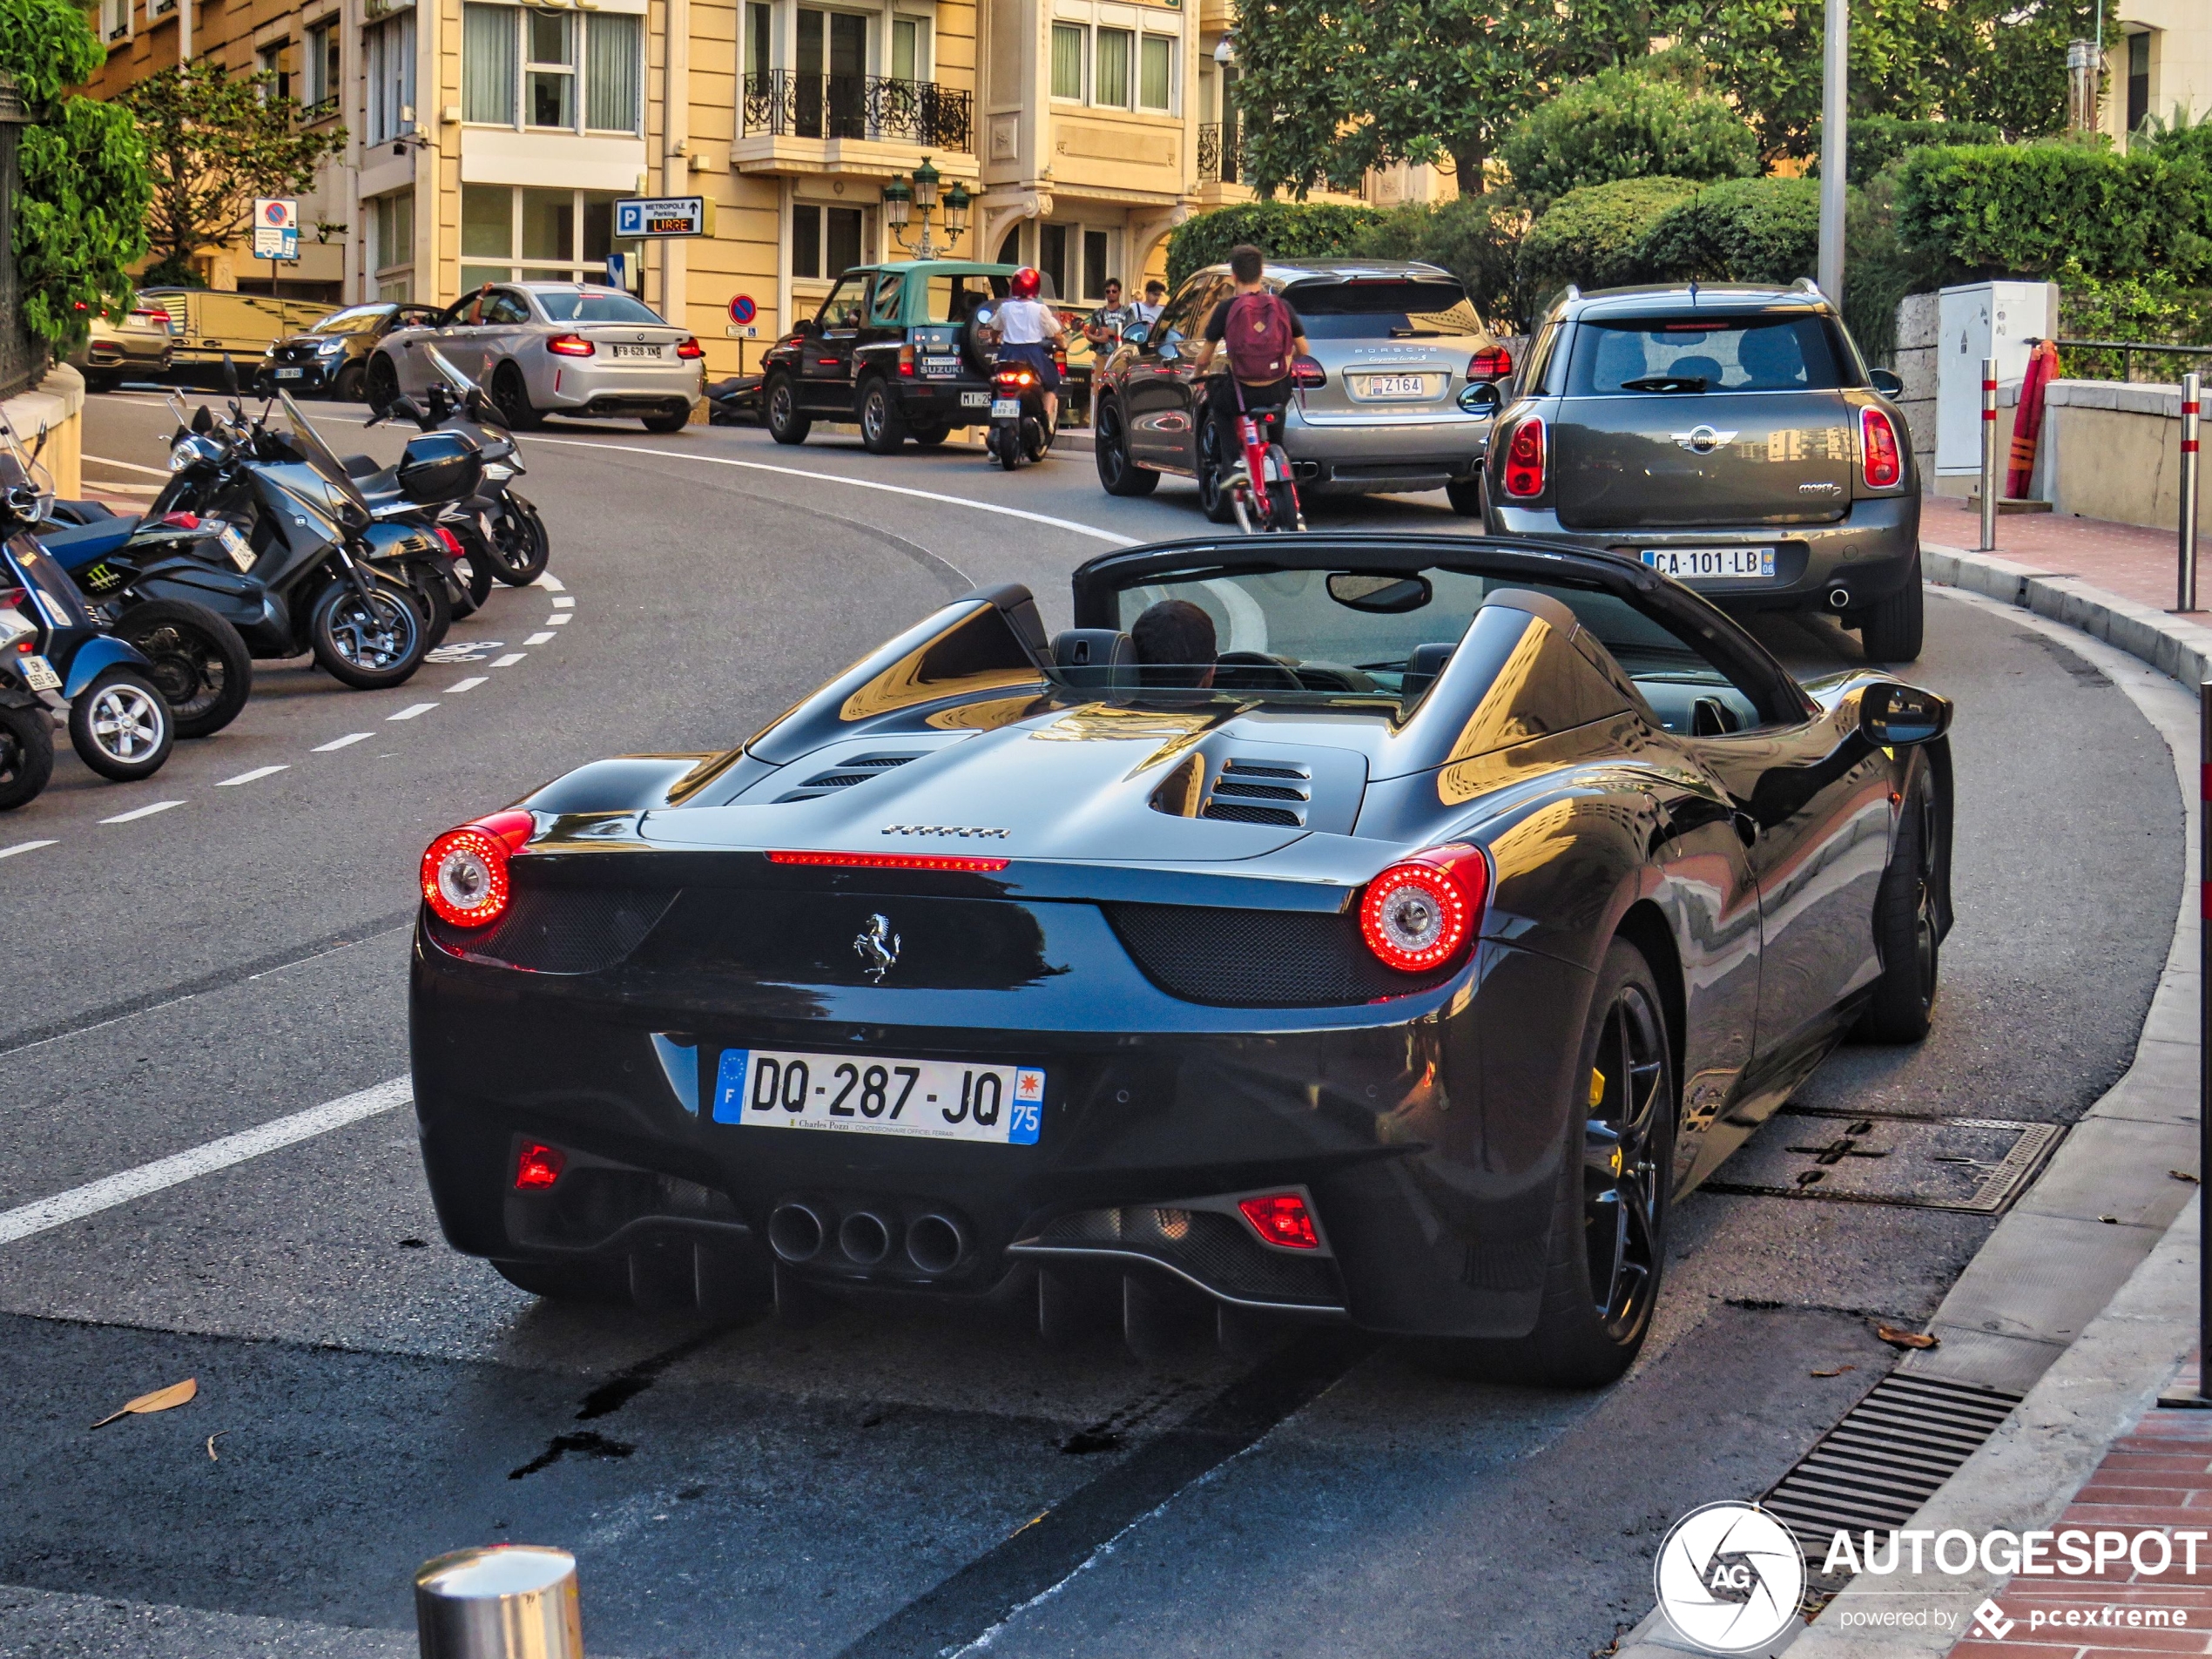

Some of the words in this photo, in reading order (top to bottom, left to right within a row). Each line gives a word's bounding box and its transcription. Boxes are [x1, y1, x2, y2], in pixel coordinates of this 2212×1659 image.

[653, 219, 688, 232] LIBRE
[1386, 377, 1419, 391] Z164
[1693, 435, 1716, 445] MINI
[1799, 483, 1833, 494] COOPER
[1656, 551, 1757, 574] CA-101-LB
[1763, 564, 1774, 574] 06
[725, 1089, 735, 1103] F
[752, 1057, 1001, 1126] DQ-287-JQ
[1011, 1105, 1039, 1131] 75
[799, 1119, 827, 1130] Charles
[829, 1121, 849, 1131] Pozzi
